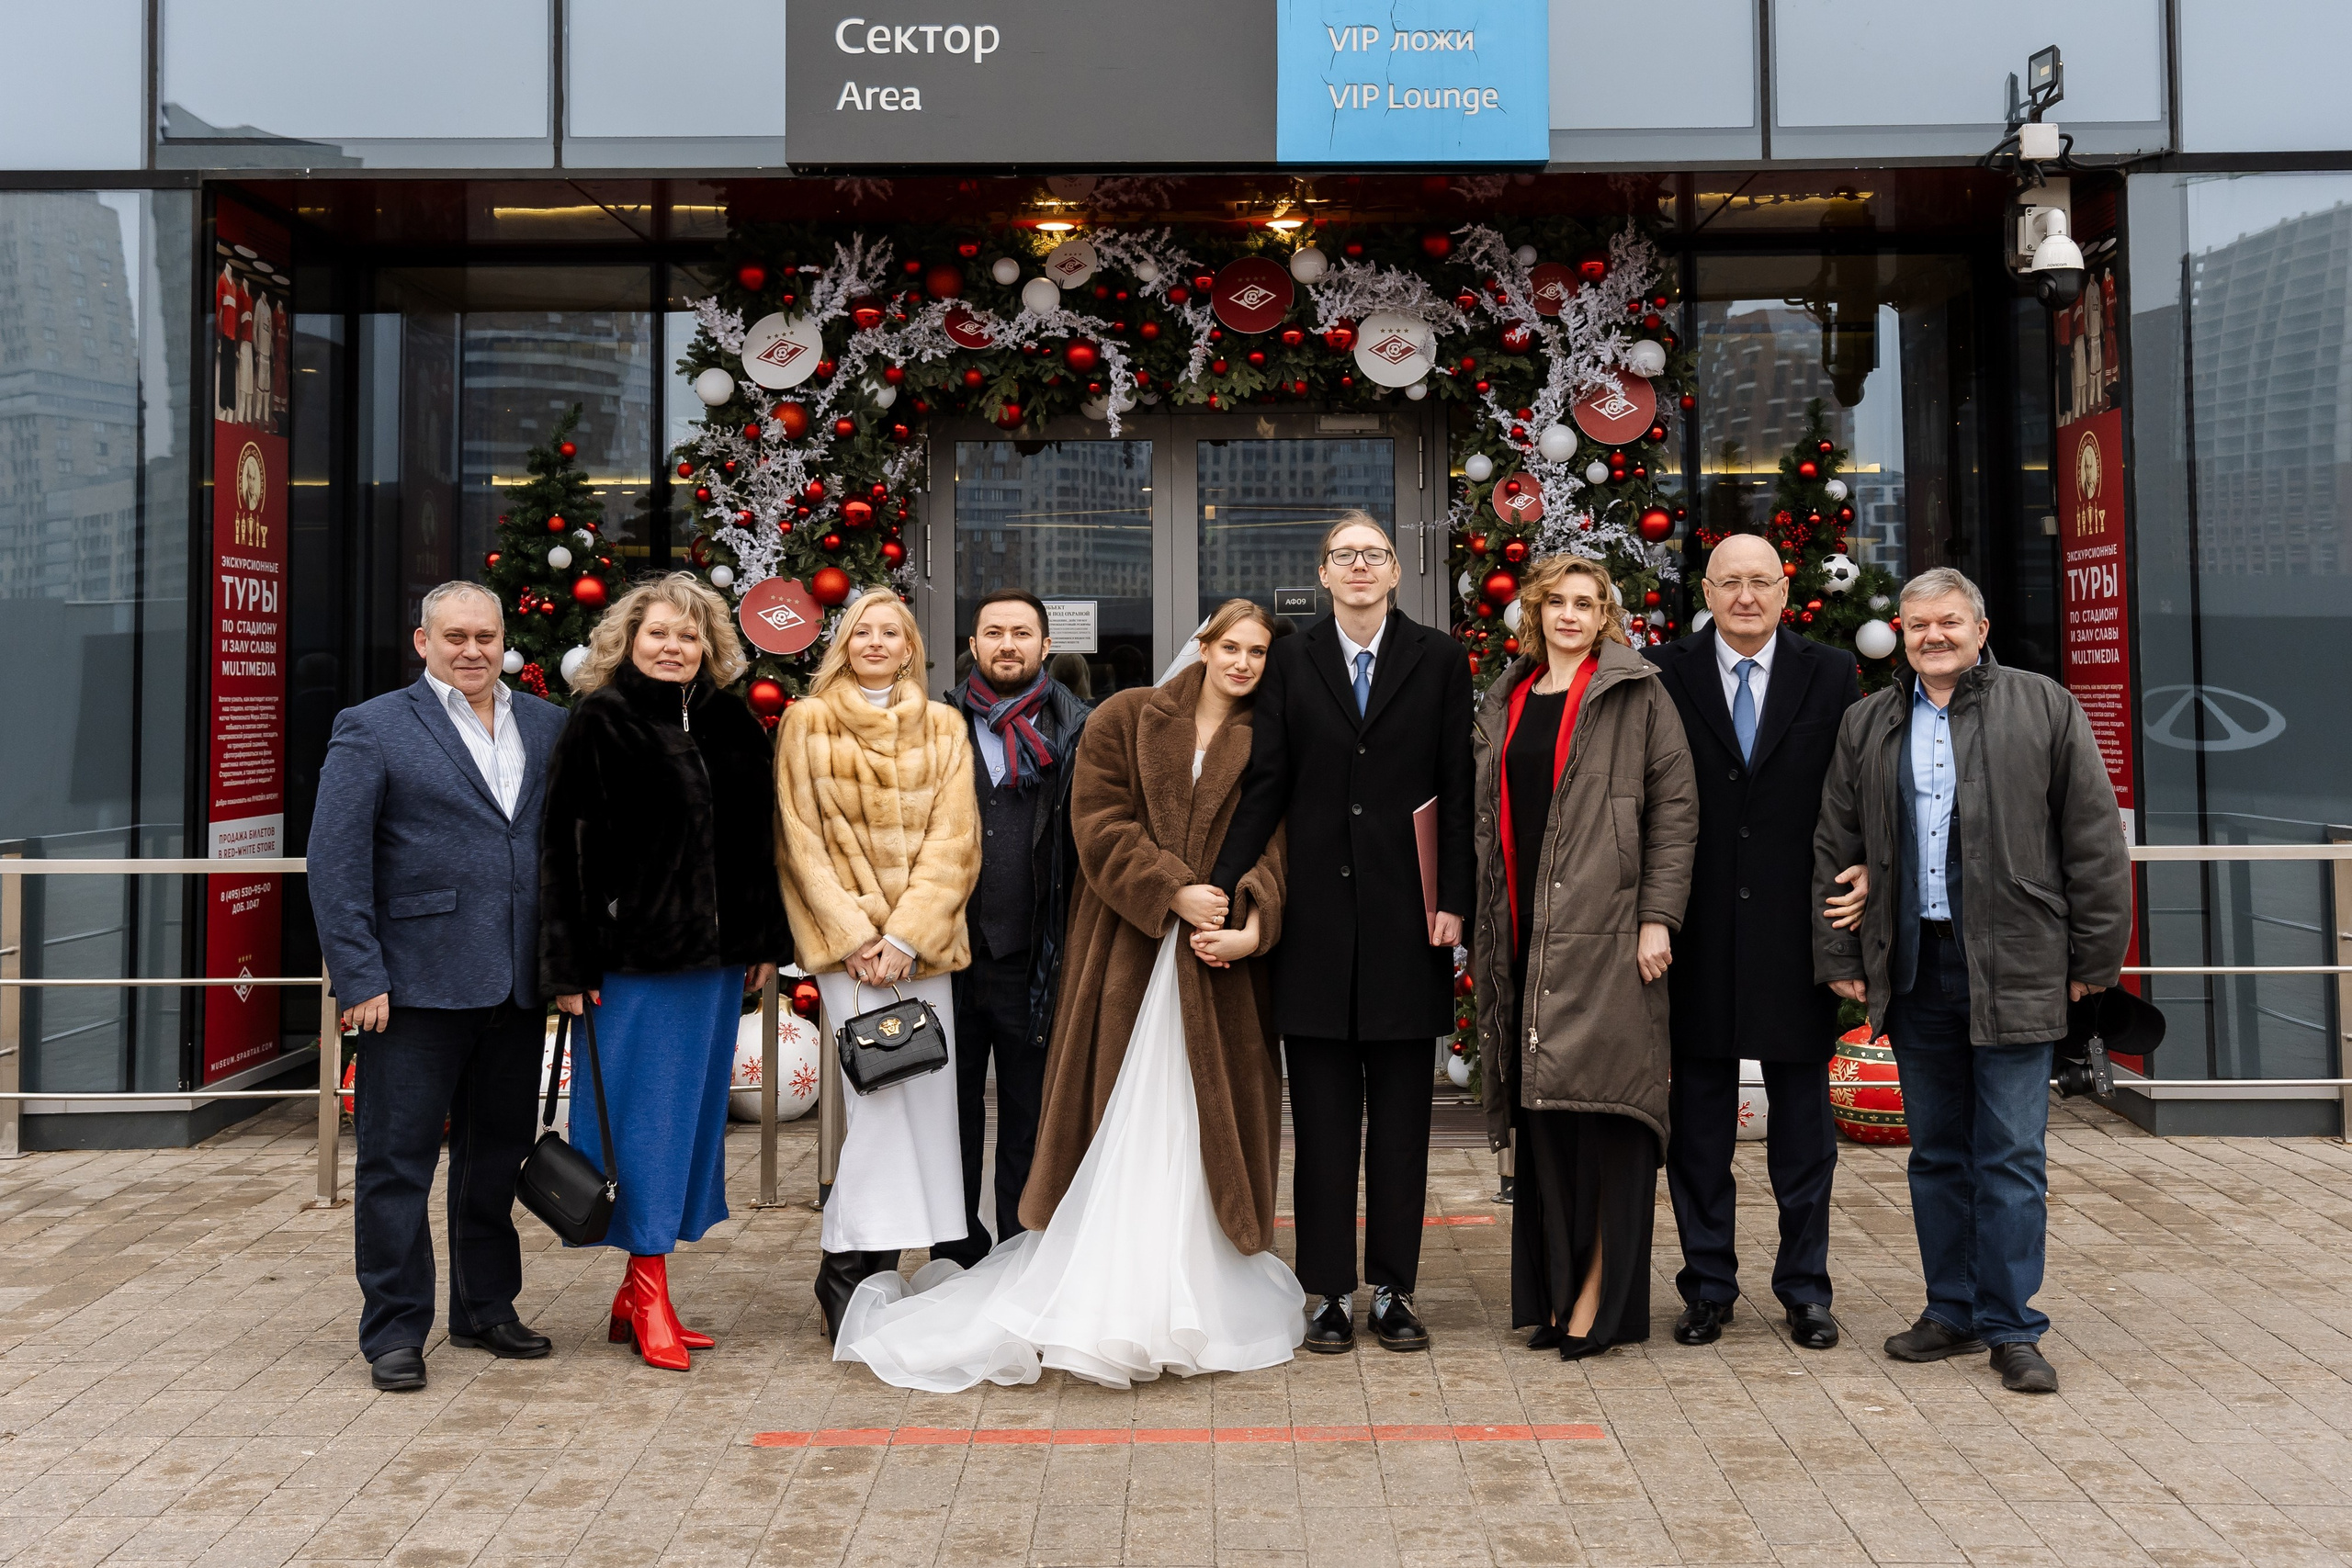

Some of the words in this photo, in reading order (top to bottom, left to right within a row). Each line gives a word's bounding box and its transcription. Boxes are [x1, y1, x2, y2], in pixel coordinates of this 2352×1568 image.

[836, 18, 999, 62] Сектор
[1329, 28, 1378, 51] VIP
[1392, 32, 1473, 51] ложи
[836, 82, 922, 110] Area
[1329, 85, 1379, 108] VIP
[1389, 85, 1498, 114] Lounge
[2067, 544, 2117, 562] ЭКСКУРСИОННЫЕ
[221, 555, 278, 573] ЭКСКУРСИОННЫЕ
[2067, 563, 2118, 601] ТУРЫ
[221, 575, 277, 613] ТУРЫ
[2070, 610, 2079, 624] ПО
[2082, 607, 2119, 624] СТАДИОНУ
[222, 619, 233, 633] ПО
[237, 621, 277, 636] СТАДИОНУ
[2071, 630, 2075, 642] И
[2076, 629, 2094, 643] ЗАЛУ
[2095, 627, 2119, 641] СЛАВЫ
[222, 639, 228, 652] И
[230, 639, 249, 653] ЗАЛУ
[250, 640, 277, 654] СЛАВЫ
[2072, 648, 2120, 665] MULTIMEDIA
[222, 660, 277, 676] MULTIMEDIA
[219, 830, 247, 844] ПРОДАЖА
[249, 827, 275, 840] БИЛЕТОВ
[224, 844, 255, 858] RED-WHITE
[257, 841, 275, 852] STORE
[220, 892, 225, 902] 8
[226, 888, 241, 901] (495)
[241, 883, 271, 898] 530-95-00
[232, 902, 245, 915] ДОБ.
[210, 1042, 273, 1072] MUSEUM.SPARTAK.COM
